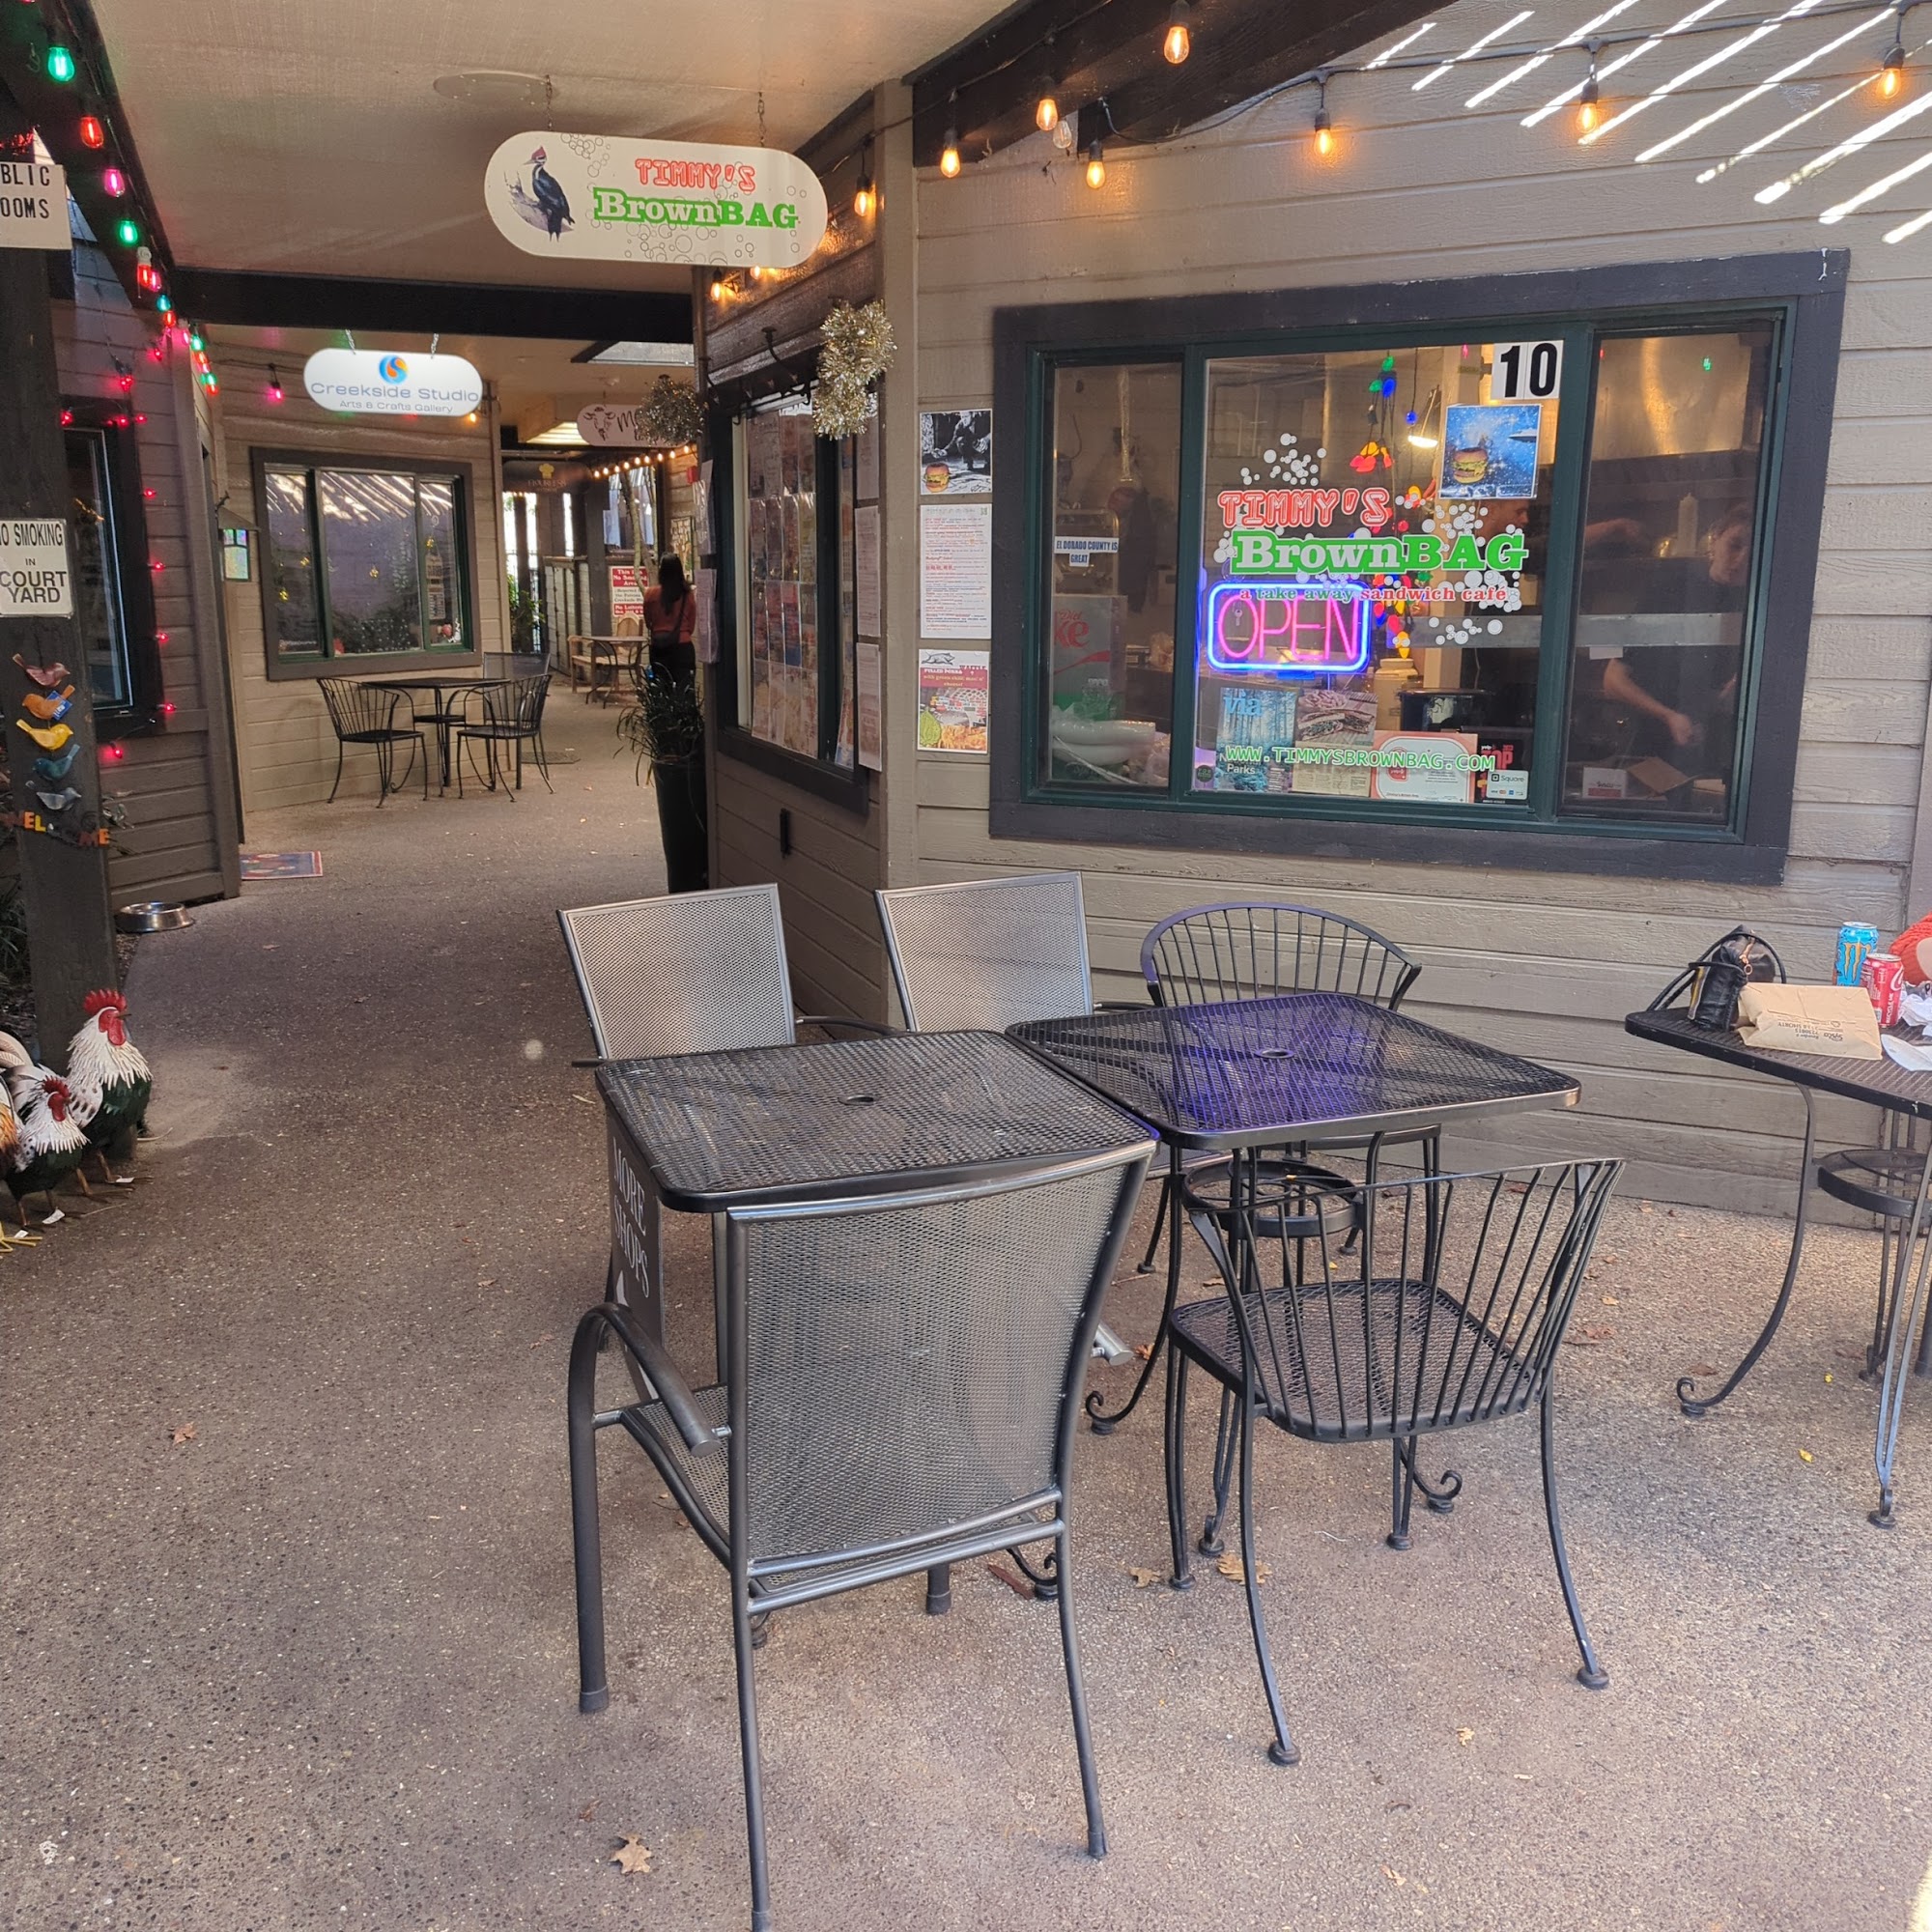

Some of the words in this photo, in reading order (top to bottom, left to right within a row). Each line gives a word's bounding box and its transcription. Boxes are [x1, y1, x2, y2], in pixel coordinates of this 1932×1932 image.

[635, 157, 755, 194] TIMMY'S
[593, 186, 799, 229] BrownBAG
[1500, 342, 1558, 398] 10
[310, 383, 412, 399] Creekside
[418, 388, 479, 402] Studio
[340, 400, 362, 409] Arts
[378, 402, 412, 412] Crafts
[414, 403, 454, 413] Gallery
[1217, 487, 1390, 528] TIMMY'S
[0, 523, 9, 547] O
[14, 523, 64, 547] SMOKING
[1064, 541, 1087, 550] DORADO
[1088, 541, 1111, 551] COUNTY
[1111, 542, 1118, 551] IS
[1230, 528, 1529, 575] BrownBAG
[1070, 554, 1088, 563] GREAT
[0, 571, 67, 587] COURT
[8, 587, 61, 603] YARD
[1239, 590, 1251, 600] a
[1257, 586, 1297, 600] take
[1305, 588, 1352, 603] away
[1360, 587, 1456, 601] sandwich
[1461, 585, 1507, 601] café
[1217, 591, 1358, 660] OPEN
[1223, 691, 1263, 717] via
[1225, 745, 1495, 773] WWW.TIMMYSBROWNBAG.COM
[1227, 762, 1256, 775] Parks
[1500, 775, 1525, 783] Square
